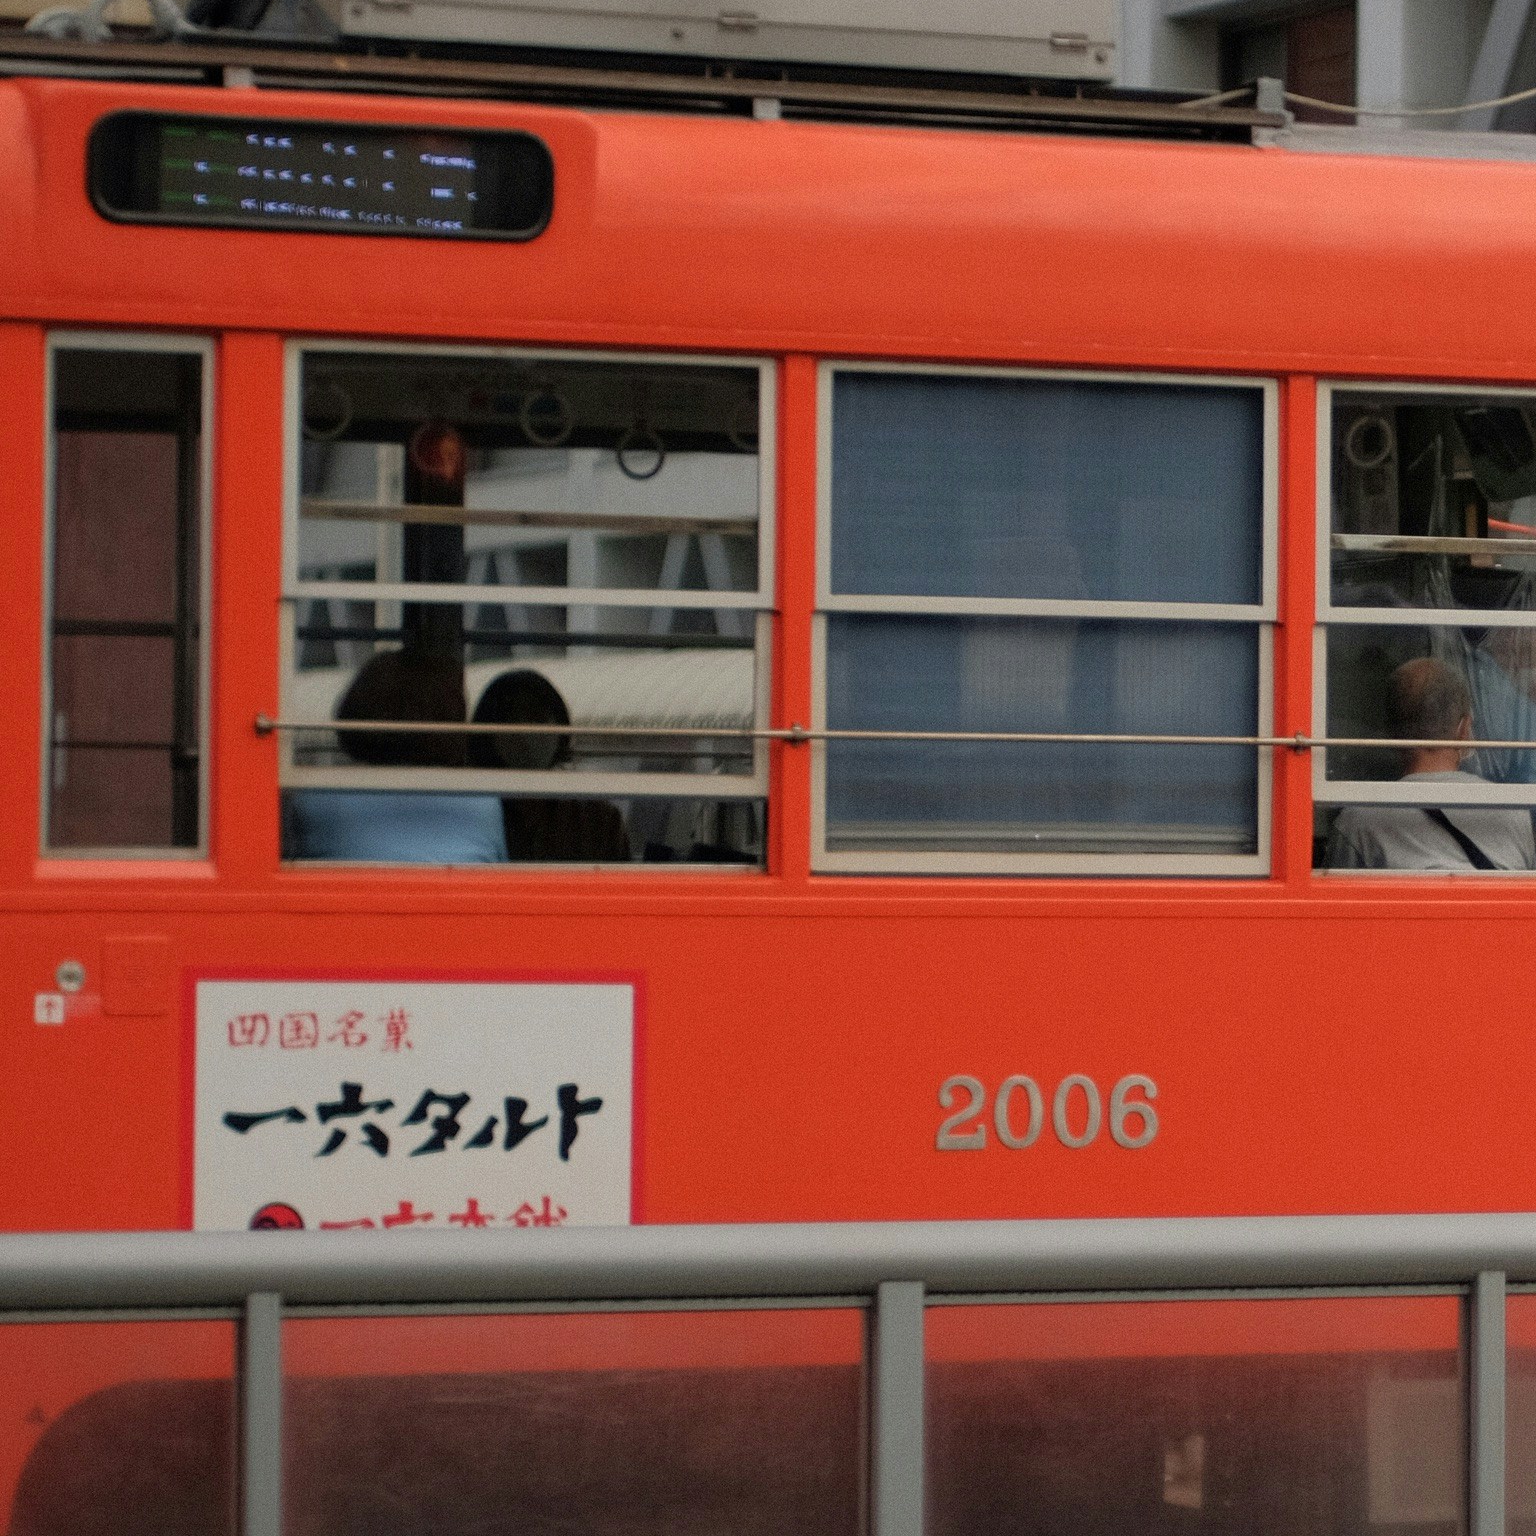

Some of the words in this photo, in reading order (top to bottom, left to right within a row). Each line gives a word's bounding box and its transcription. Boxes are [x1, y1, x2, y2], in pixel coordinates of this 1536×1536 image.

[227, 1008, 415, 1052] 四国名菓
[222, 1081, 603, 1162] 一六タルト
[935, 1073, 1159, 1151] 2006
